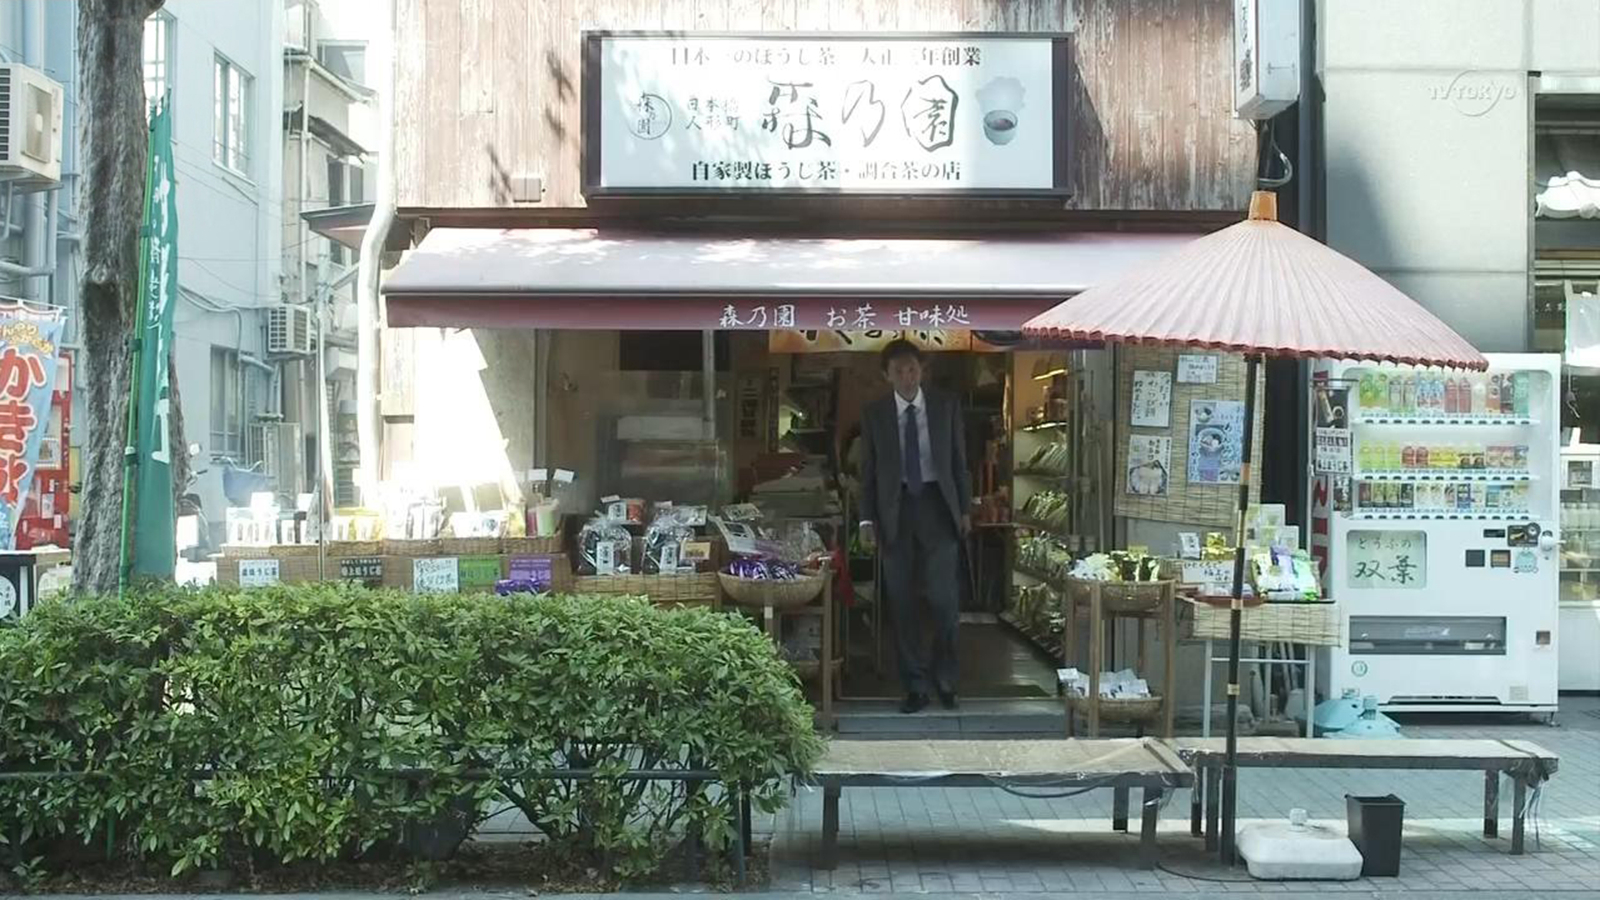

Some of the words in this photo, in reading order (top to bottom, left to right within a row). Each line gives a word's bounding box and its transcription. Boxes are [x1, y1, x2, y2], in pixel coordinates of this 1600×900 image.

[719, 304, 796, 328] 森乃園
[826, 303, 877, 329] お茶
[892, 304, 971, 328] 甘味処
[1359, 537, 1412, 550] とうふの
[1354, 555, 1418, 585] 双葉
